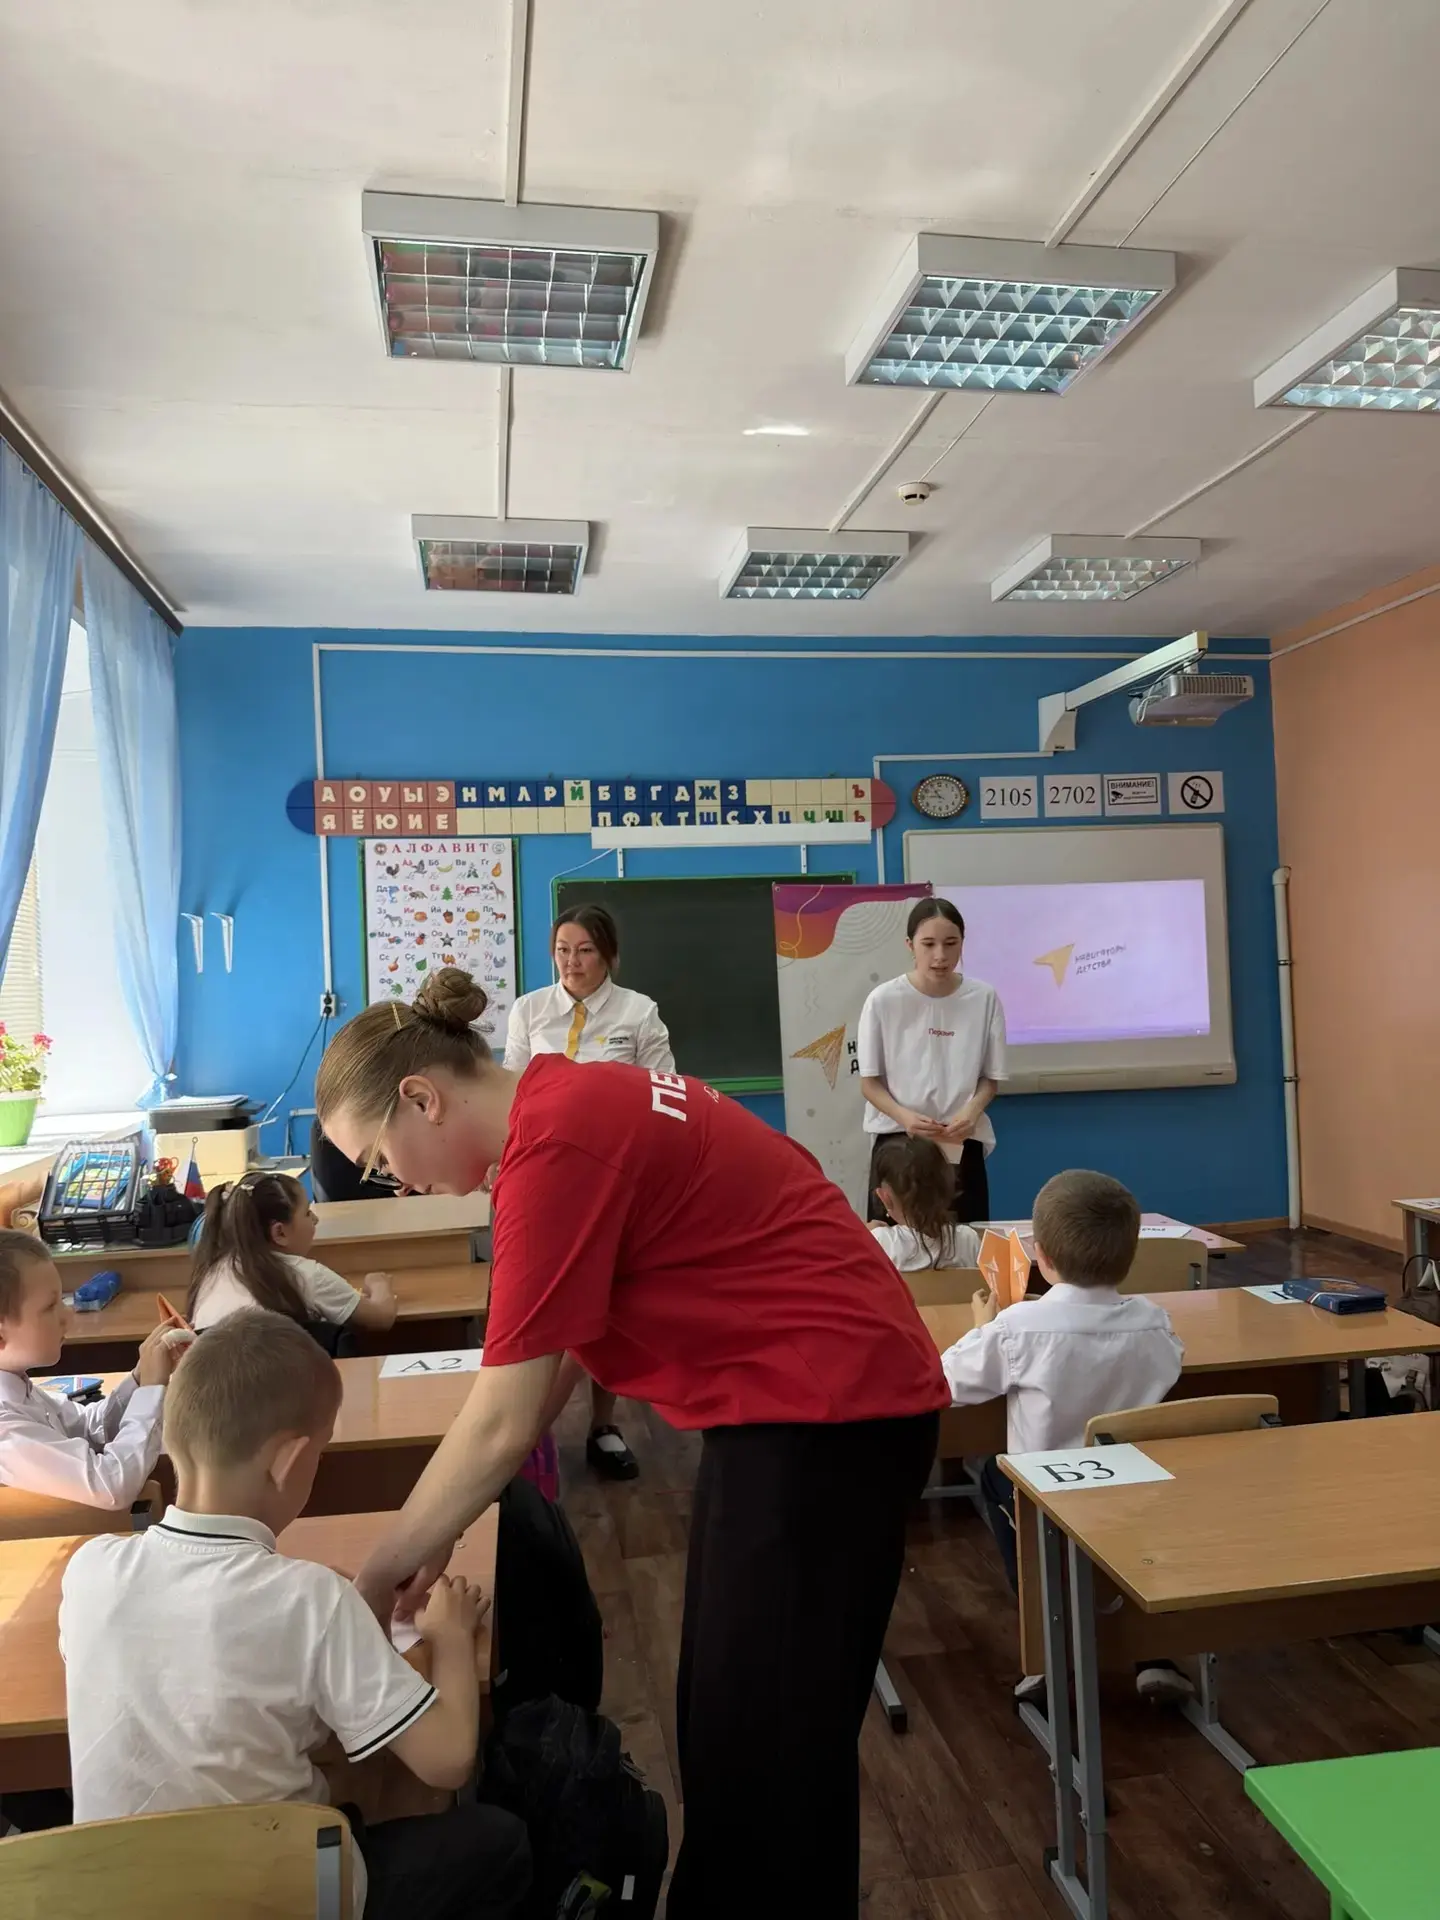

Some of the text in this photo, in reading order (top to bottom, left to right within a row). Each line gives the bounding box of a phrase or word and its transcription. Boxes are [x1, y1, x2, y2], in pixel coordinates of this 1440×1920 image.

[1110, 780, 1156, 789] ВНИМАНИЕ!
[985, 788, 1032, 807] 2105
[1049, 786, 1096, 805] 2702
[392, 842, 489, 854] АЛФАВИТ
[649, 1070, 687, 1122] ПЕ
[398, 1357, 463, 1373] А2
[1035, 1460, 1115, 1484] Б3
